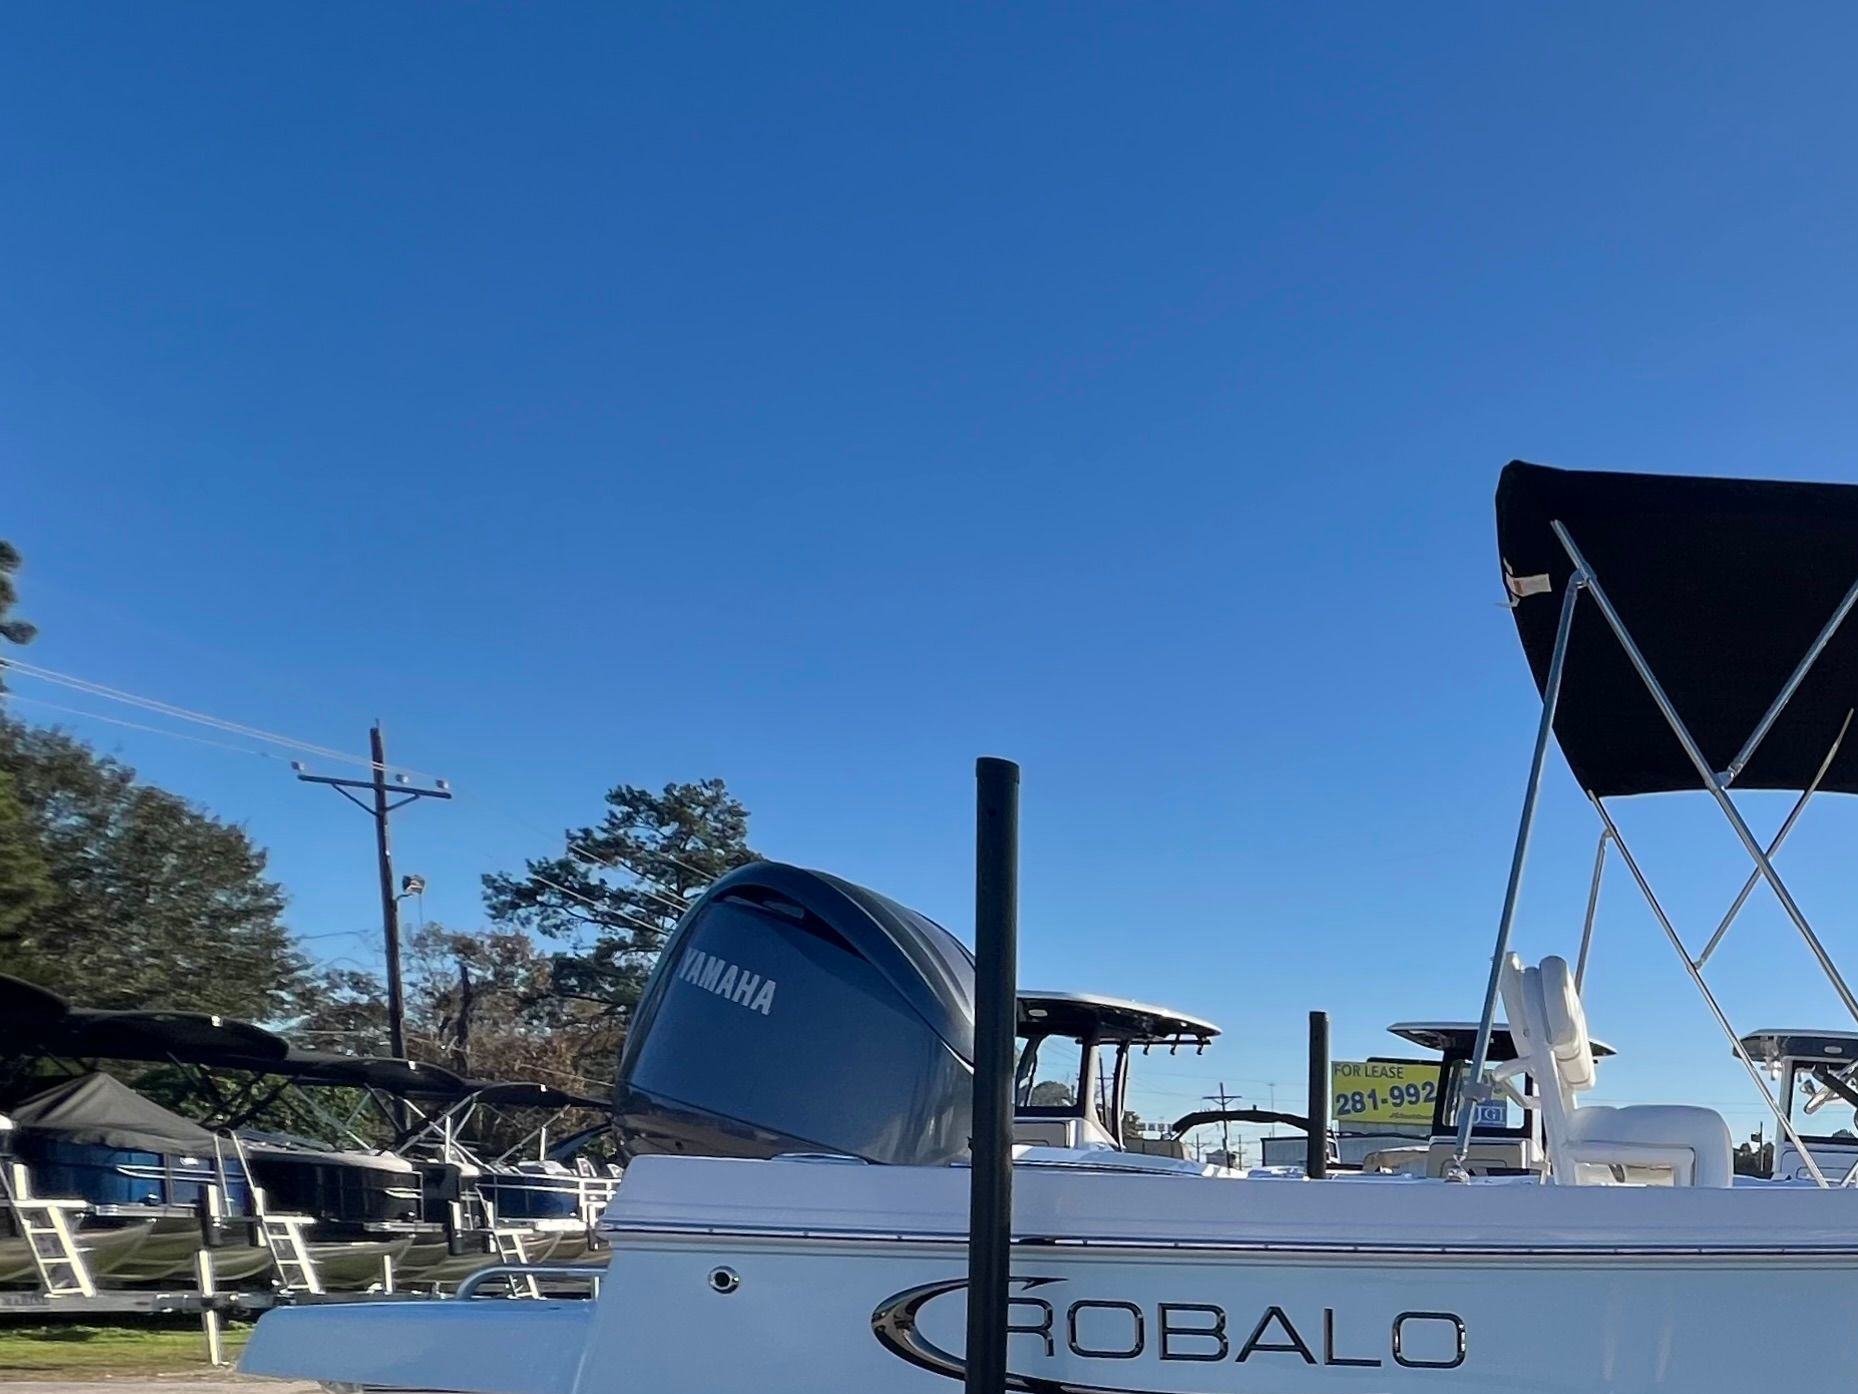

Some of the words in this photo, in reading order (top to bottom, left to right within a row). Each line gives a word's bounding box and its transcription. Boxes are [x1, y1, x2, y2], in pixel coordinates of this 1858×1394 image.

[680, 946, 776, 1016] YAMAHA
[1334, 1063, 1361, 1078] FOR
[1364, 1064, 1405, 1079] LEASE
[1335, 1081, 1436, 1116] 281-992
[1006, 1296, 1467, 1370] ROBALO
